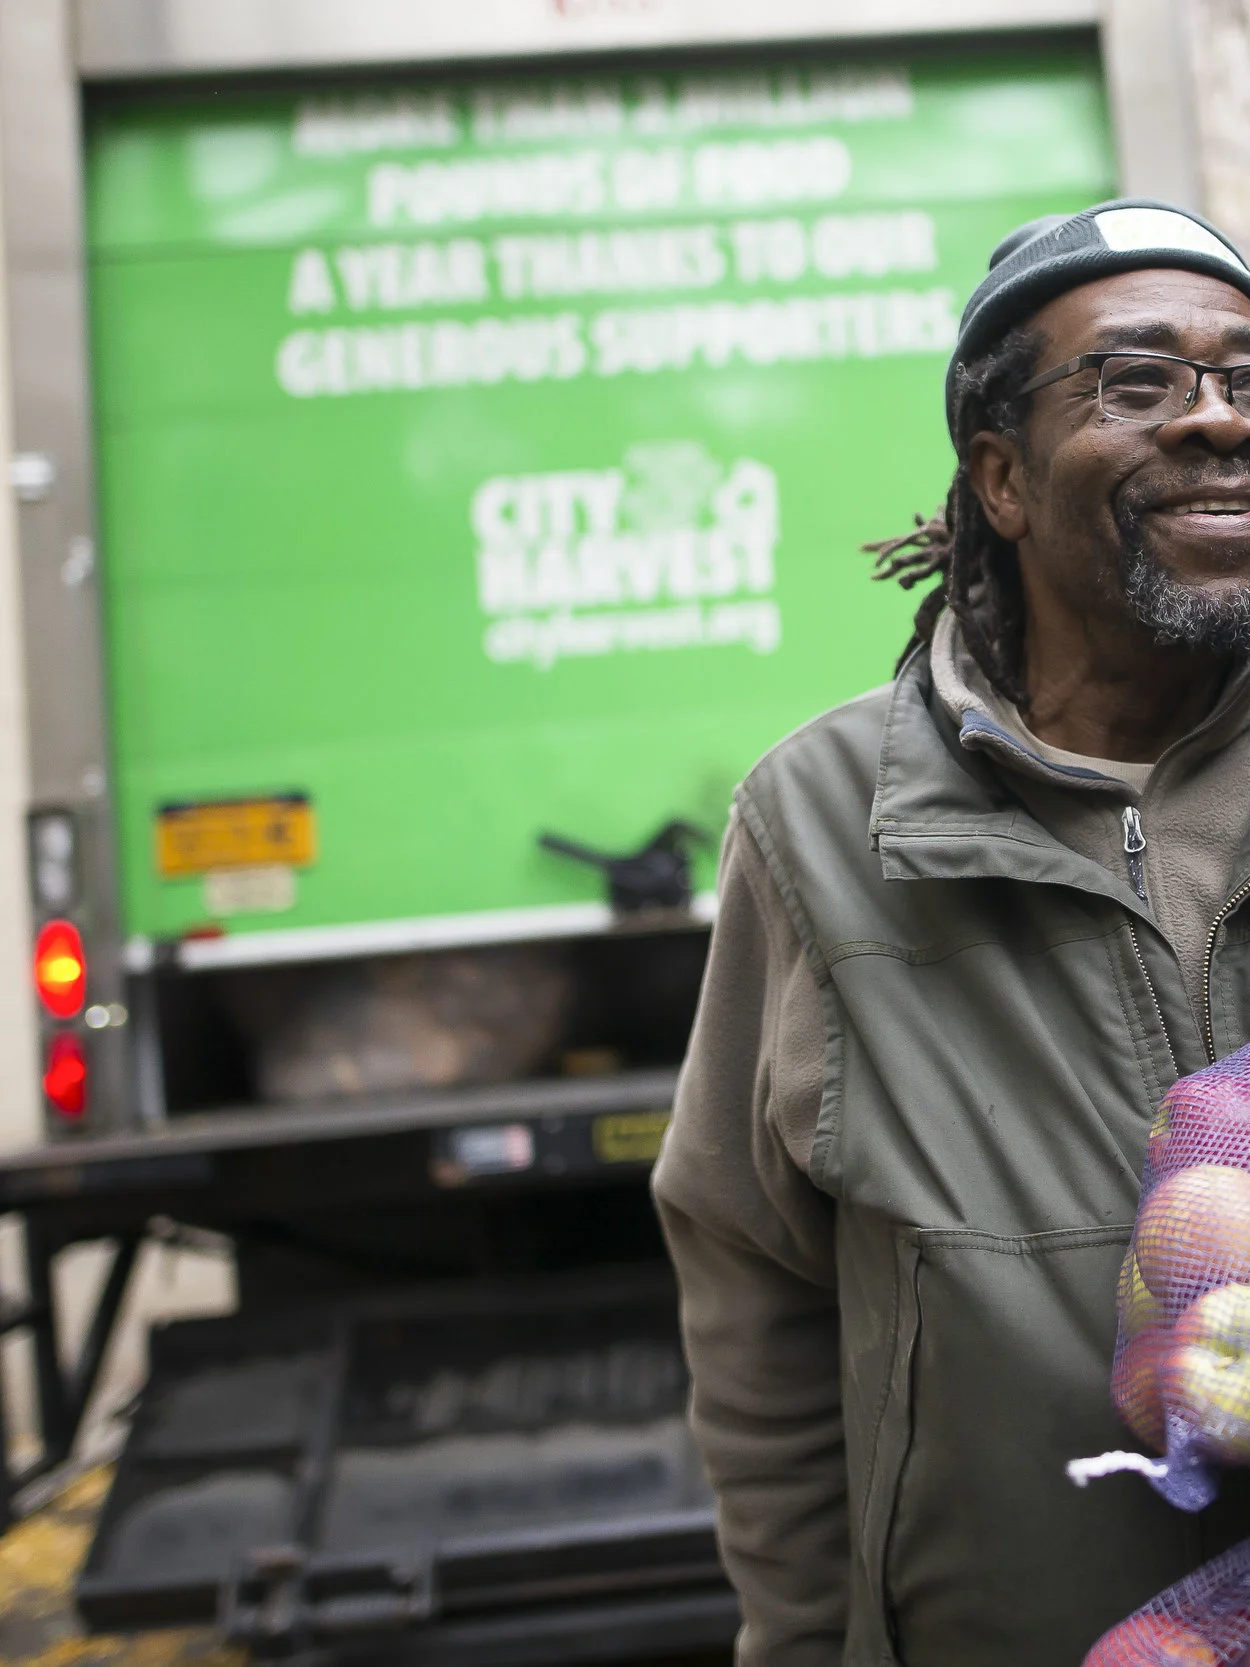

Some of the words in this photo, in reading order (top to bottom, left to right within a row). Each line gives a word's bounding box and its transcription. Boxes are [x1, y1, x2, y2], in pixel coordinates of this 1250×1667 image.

[367, 153, 607, 226] POUNDS
[612, 146, 684, 212] OF
[693, 136, 852, 206] FOOD
[288, 248, 334, 314] A
[336, 238, 489, 311] YEAR
[494, 224, 726, 298] THANKS
[731, 217, 806, 283] TO
[812, 211, 938, 276] OUR
[275, 311, 587, 397] GENEROUS
[589, 290, 957, 377] SUPPORTERS
[473, 468, 624, 541] CITY
[479, 530, 776, 615] HARVEST
